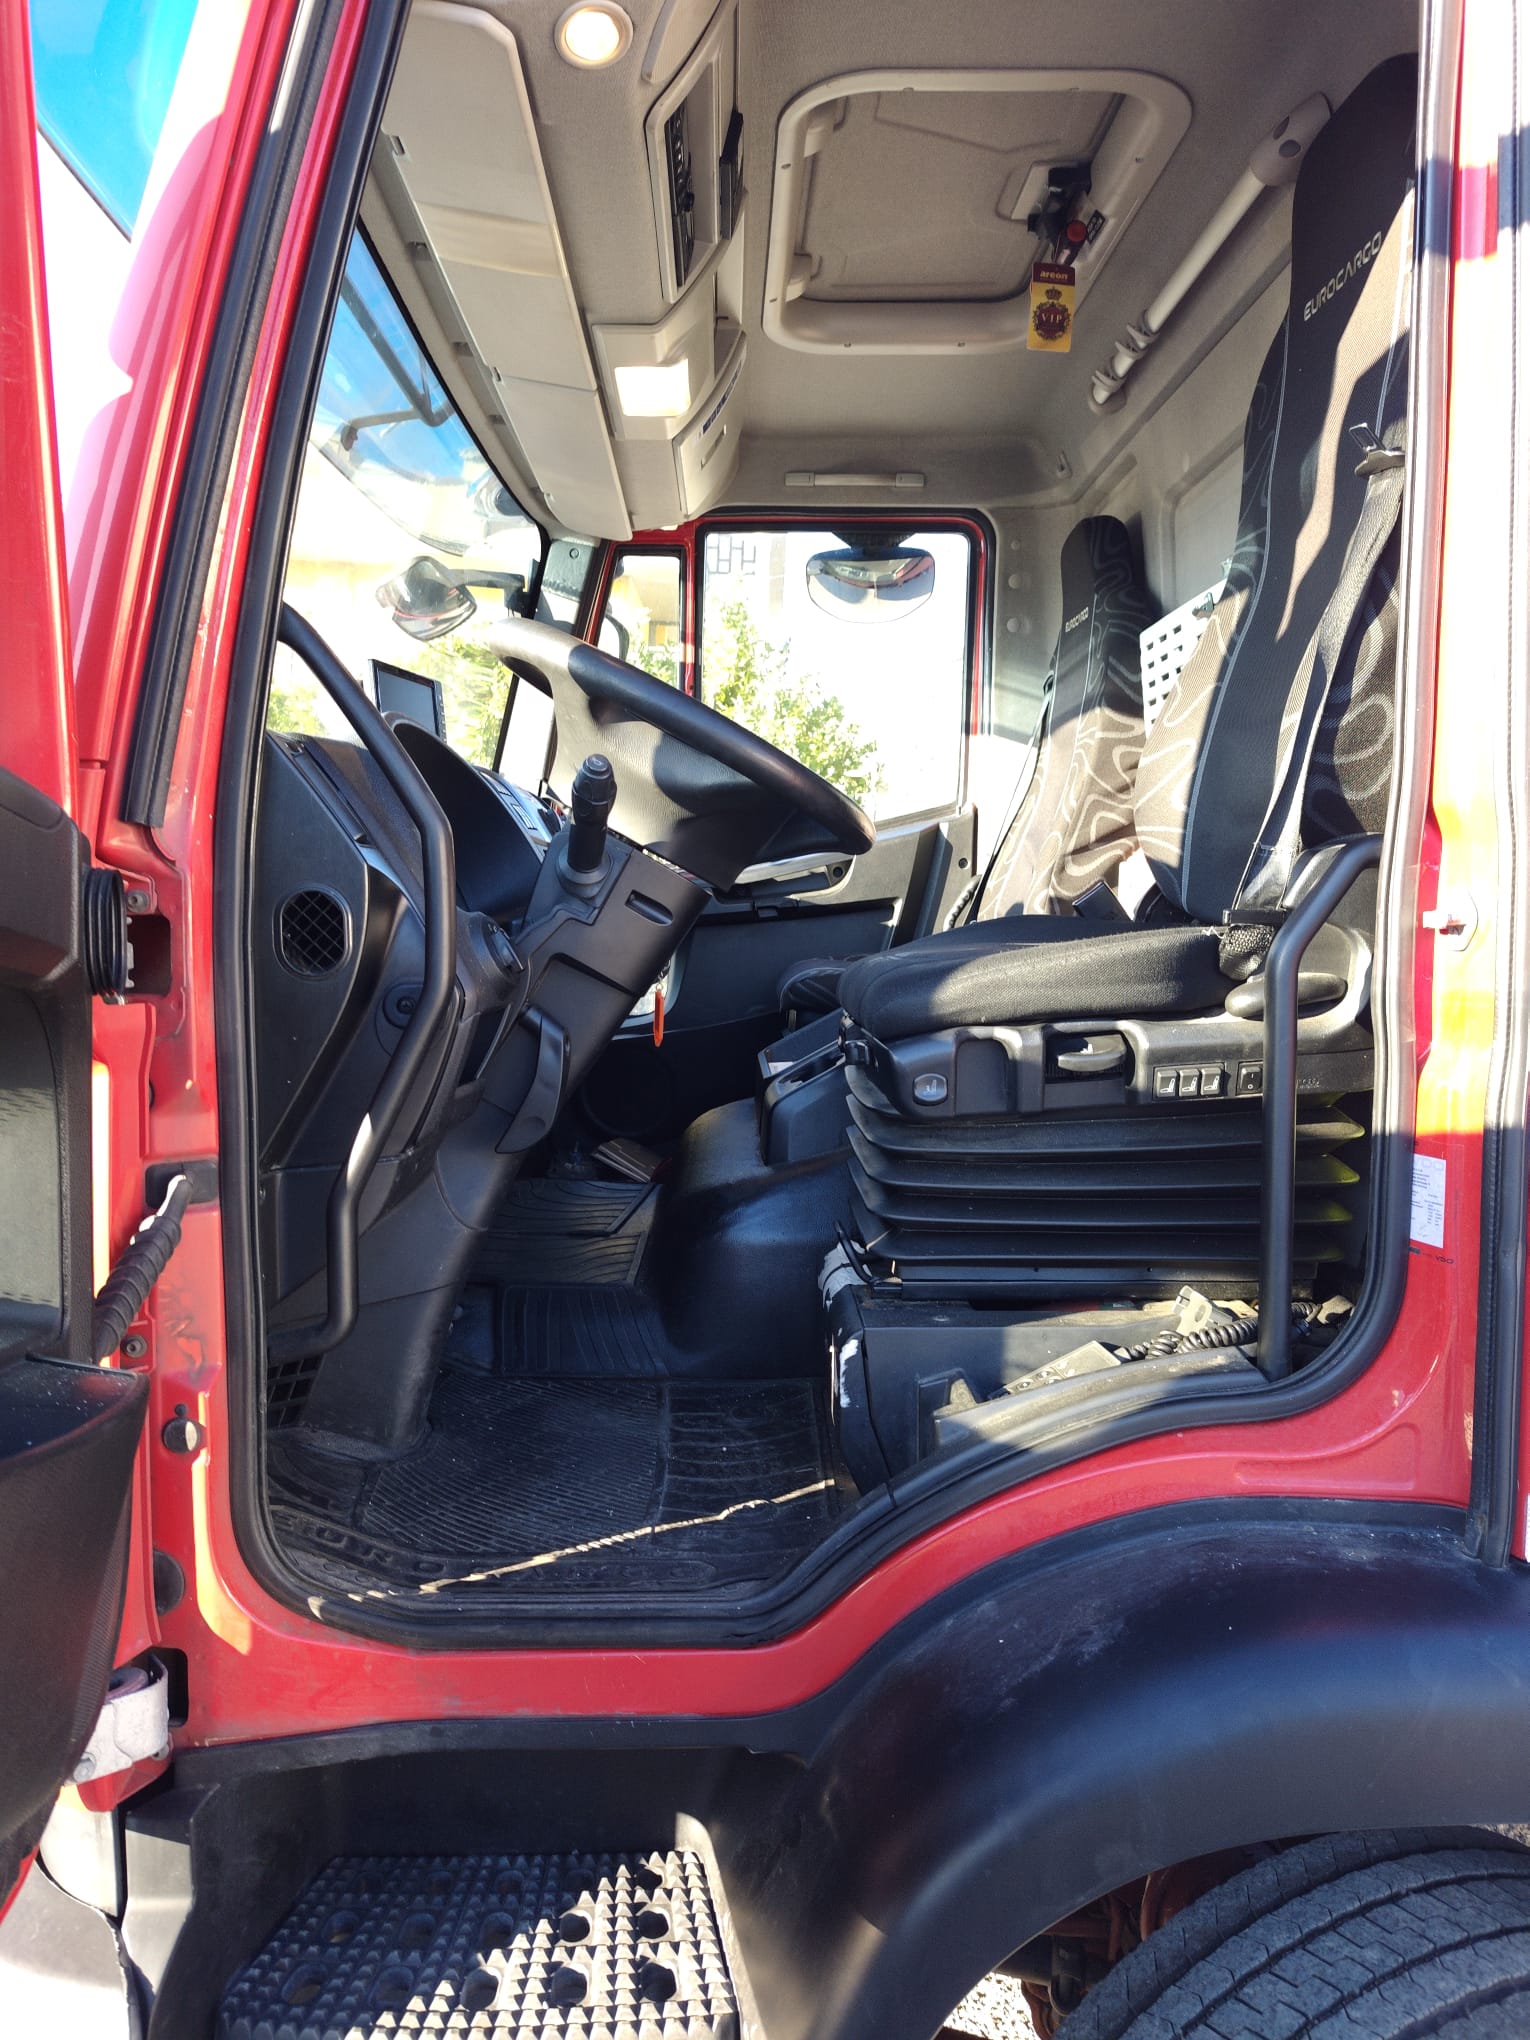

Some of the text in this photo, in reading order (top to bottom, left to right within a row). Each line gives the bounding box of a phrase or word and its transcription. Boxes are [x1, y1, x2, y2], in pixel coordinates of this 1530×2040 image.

[1039, 271, 1068, 280] areon
[1304, 231, 1382, 321] EUROCARGO
[1041, 313, 1063, 324] VIP
